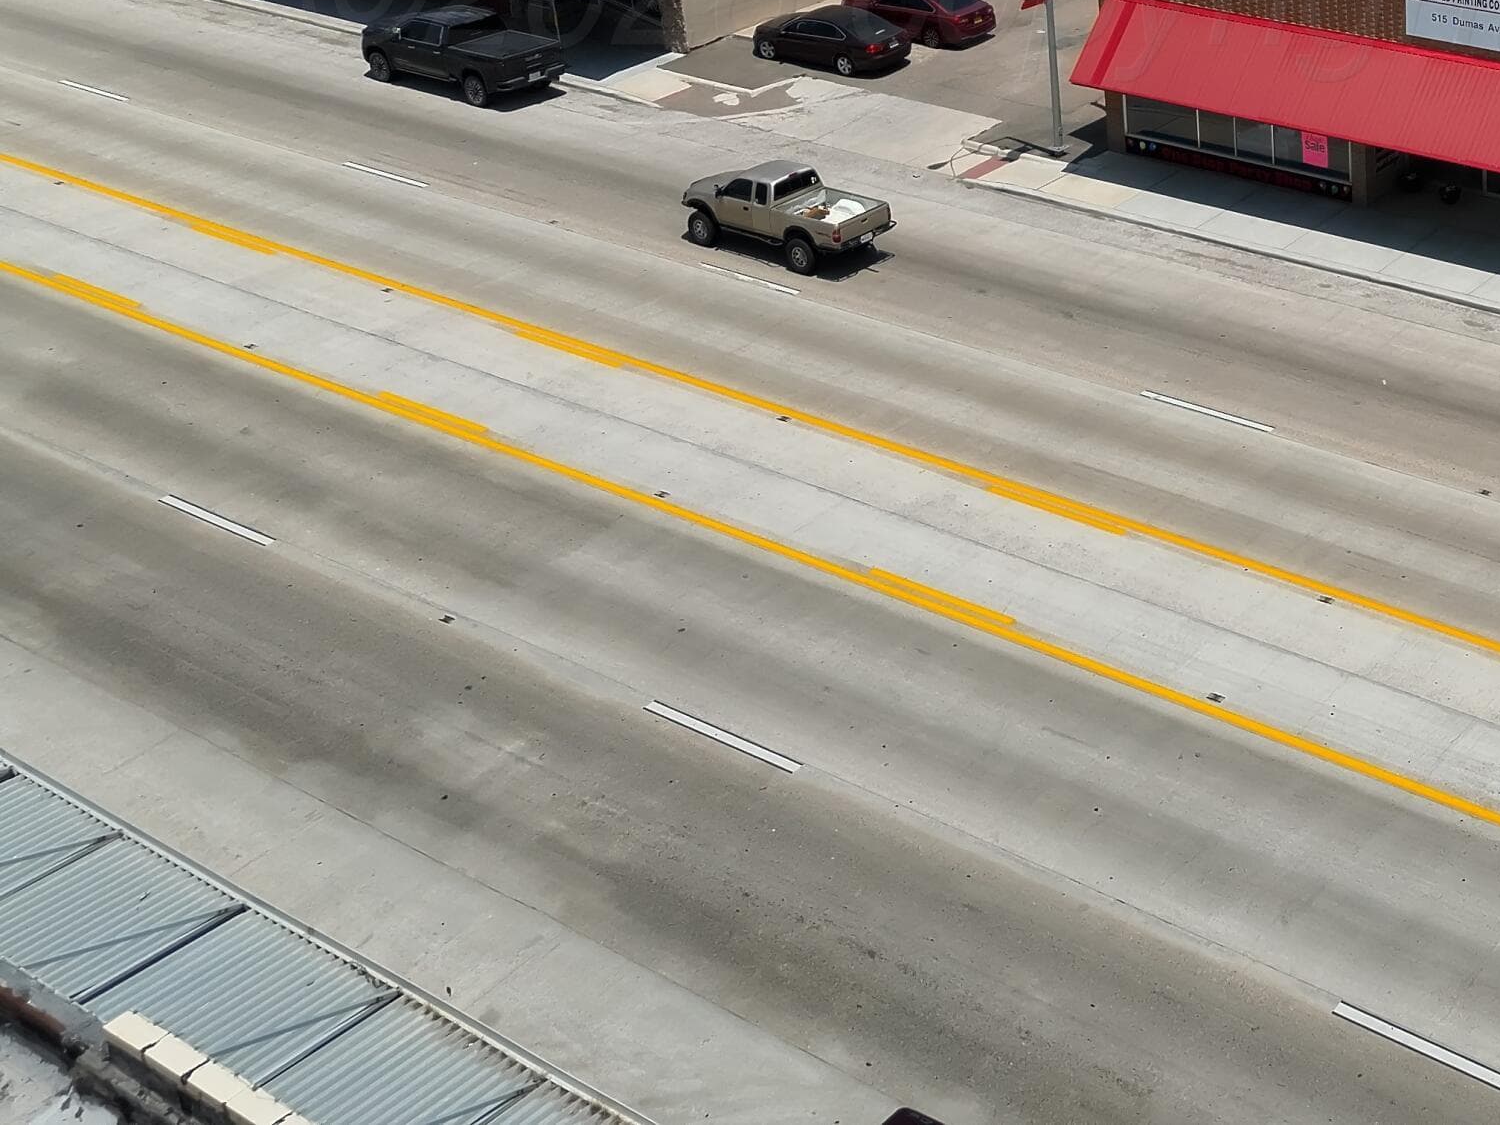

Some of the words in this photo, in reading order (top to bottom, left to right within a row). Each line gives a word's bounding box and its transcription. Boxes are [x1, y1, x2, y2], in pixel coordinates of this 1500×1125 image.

[1431, 13, 1448, 24] 515
[1453, 16, 1484, 31] Dumas
[1304, 140, 1325, 153] Sale
